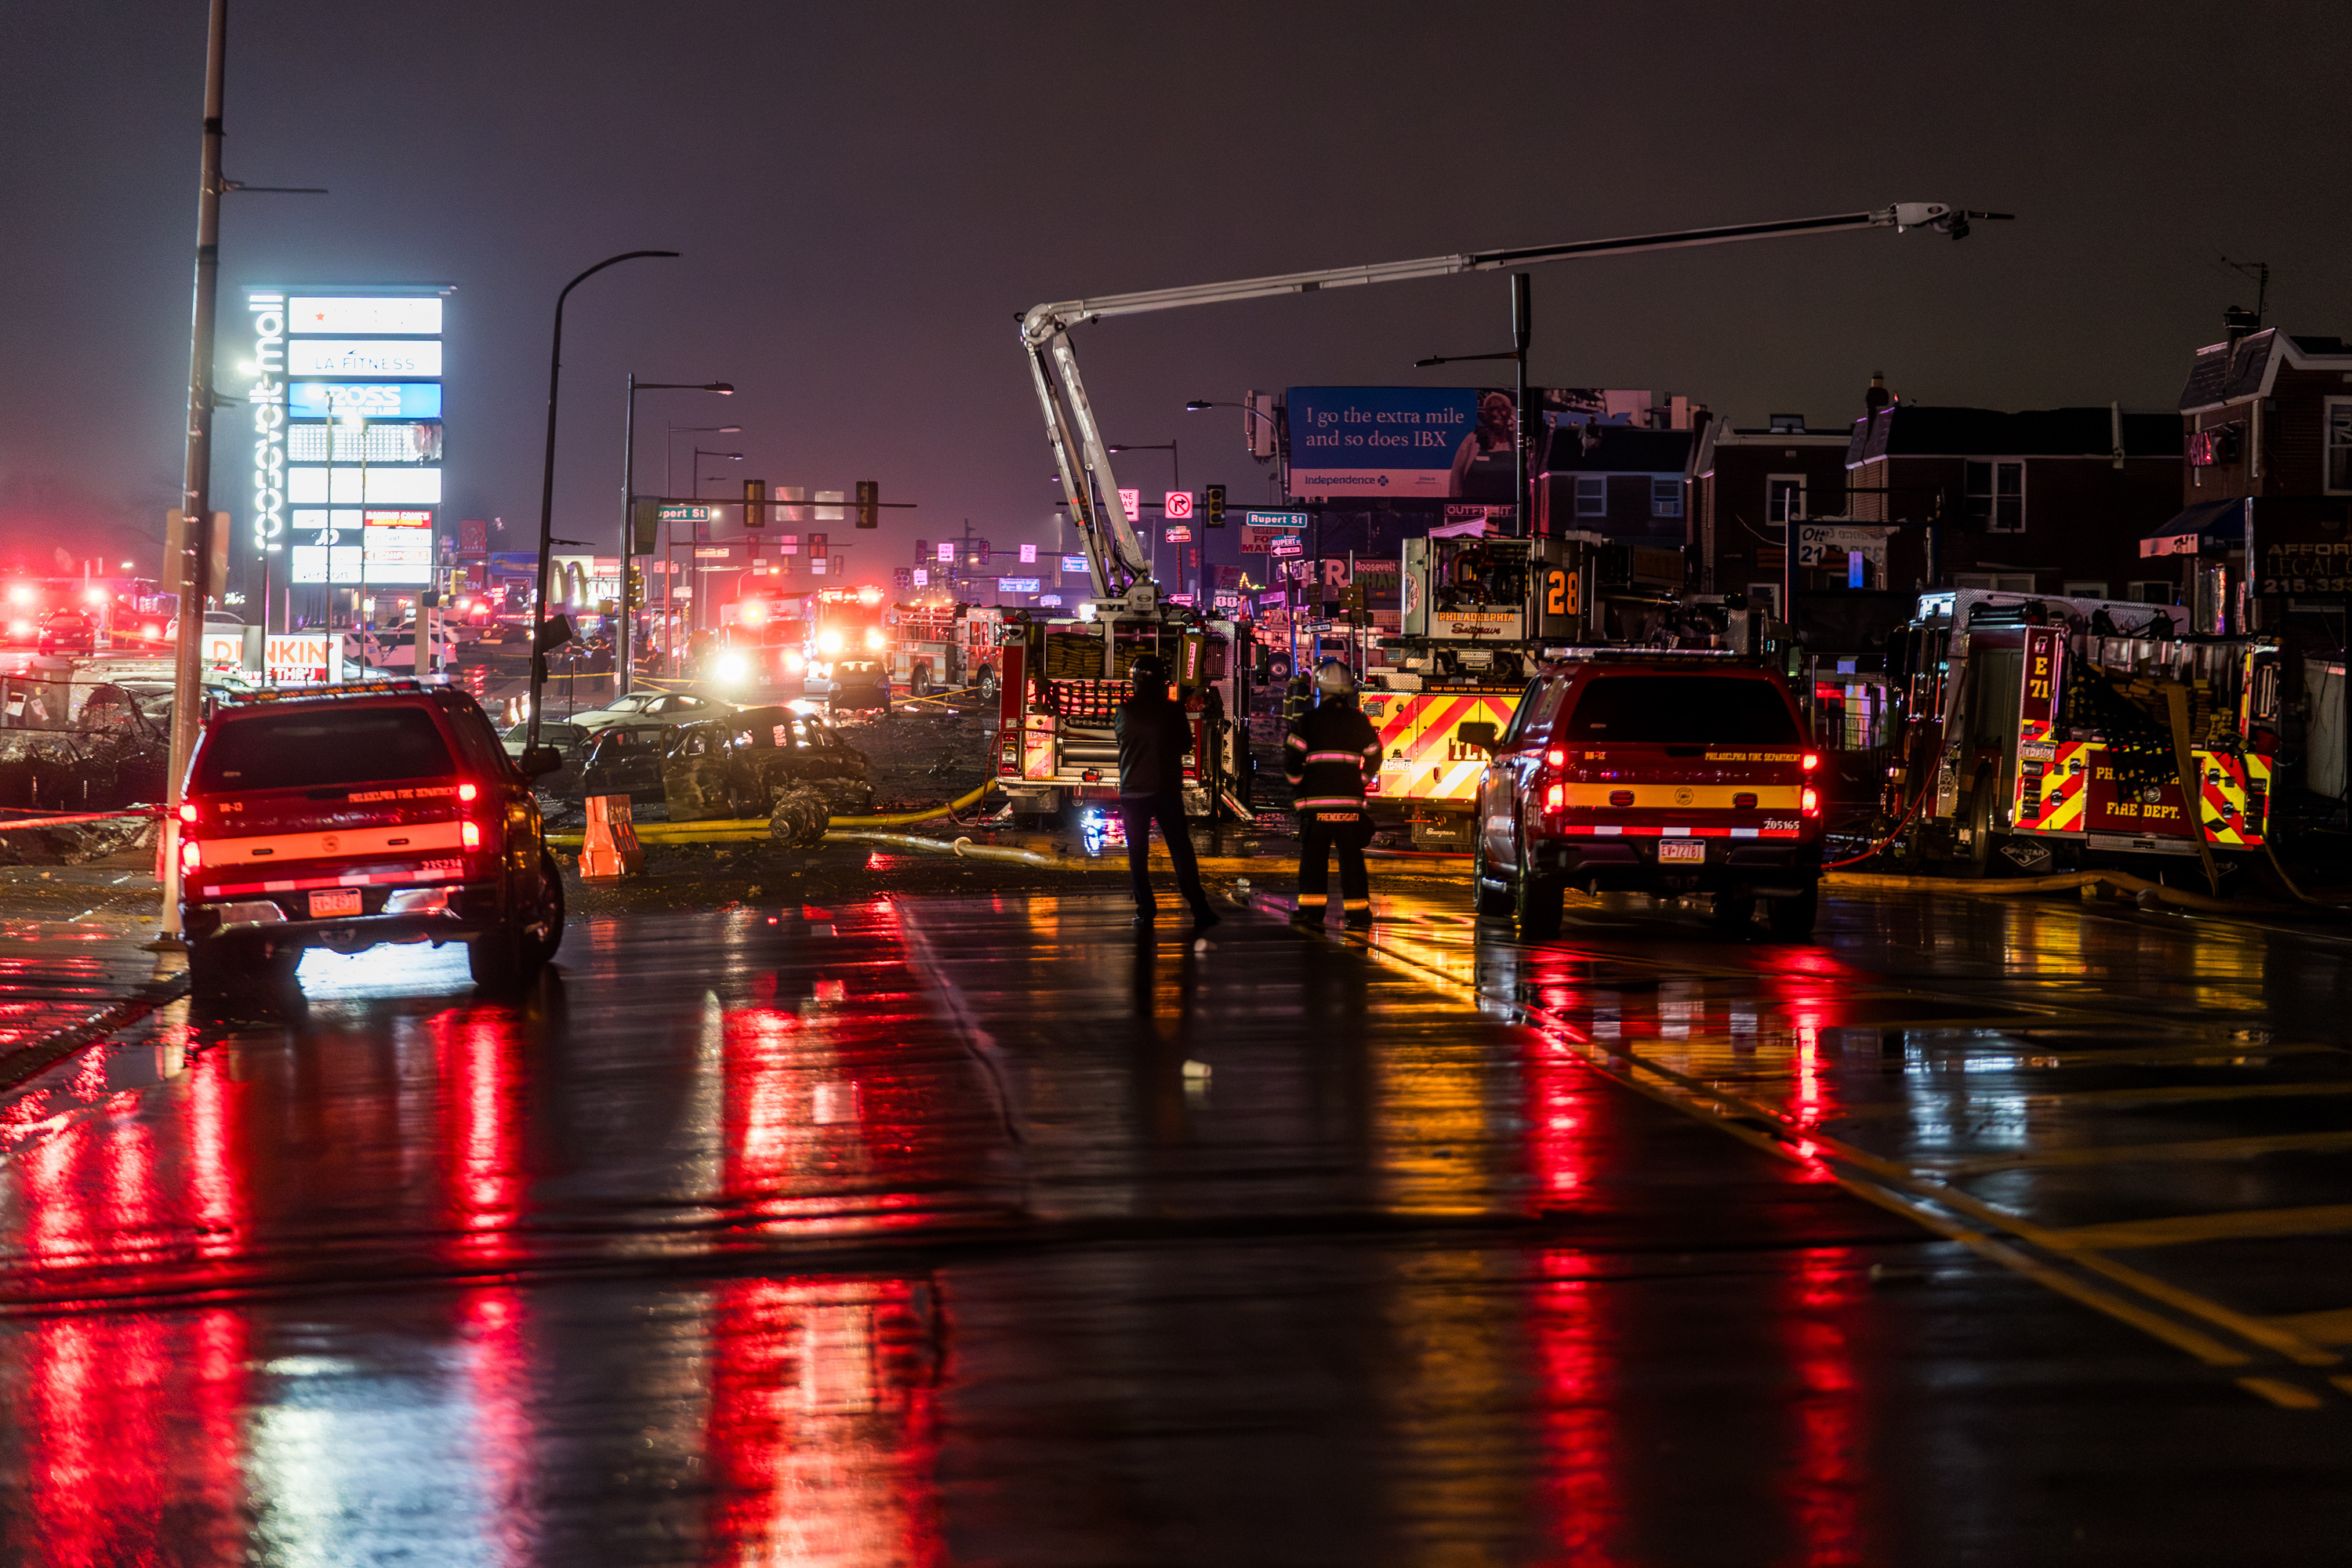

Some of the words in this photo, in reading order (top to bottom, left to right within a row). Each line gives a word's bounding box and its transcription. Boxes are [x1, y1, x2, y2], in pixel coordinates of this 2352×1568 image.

[249, 296, 283, 372] mall
[315, 358, 334, 369] LA
[343, 358, 415, 370] FITNESS
[1307, 408, 1312, 423] I
[1317, 412, 1338, 427] go
[1344, 407, 1371, 423] the
[1377, 410, 1420, 423] extra
[1425, 408, 1465, 423] mile
[1306, 430, 1339, 446] and
[1344, 434, 1363, 446] so
[1368, 430, 1409, 446] does
[1414, 431, 1447, 447] IBX
[1305, 476, 1375, 486] Independence
[692, 509, 705, 518] St
[1250, 514, 1287, 524] Rupert
[2268, 543, 2352, 555] AFFOR
[1355, 561, 1396, 572] Roosevelt
[2267, 557, 2339, 576] LEGAL
[1355, 573, 1400, 588] PHAR
[1548, 571, 1578, 615] 28
[1439, 613, 1515, 622] PHILADELPHIA
[212, 641, 334, 665] DNKIN'
[2034, 657, 2049, 675] E
[2030, 679, 2049, 699] 71
[2143, 804, 2180, 819] DEPT.
[1764, 820, 1800, 829] 205165
